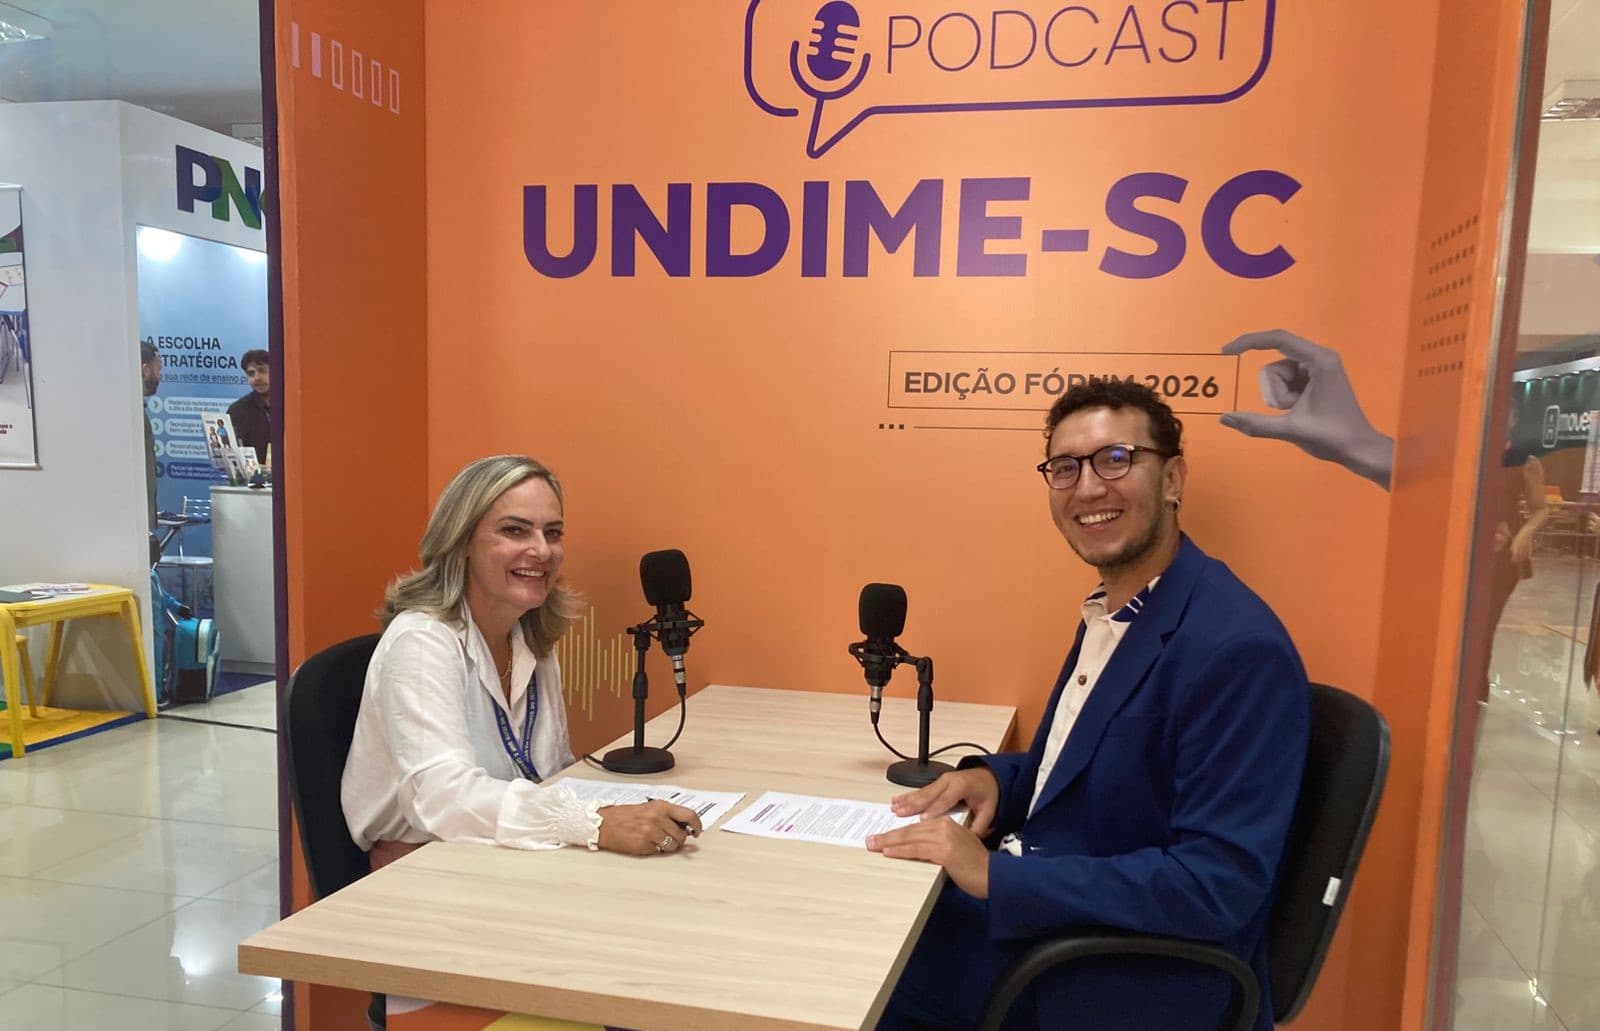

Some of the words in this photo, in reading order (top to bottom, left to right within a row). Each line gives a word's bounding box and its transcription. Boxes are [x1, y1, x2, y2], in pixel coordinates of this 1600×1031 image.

[888, 0, 1244, 73] PODCAST
[176, 144, 265, 230] PN
[523, 170, 1302, 279] UNDIME-SC
[158, 336, 221, 350] ESCOLHA
[159, 351, 238, 369] TRATÉGICA
[181, 372, 198, 381] rede
[200, 372, 211, 382] de
[213, 373, 238, 383] ensino
[904, 368, 1016, 400] EDIÇÃO
[1144, 375, 1219, 398] 2026
